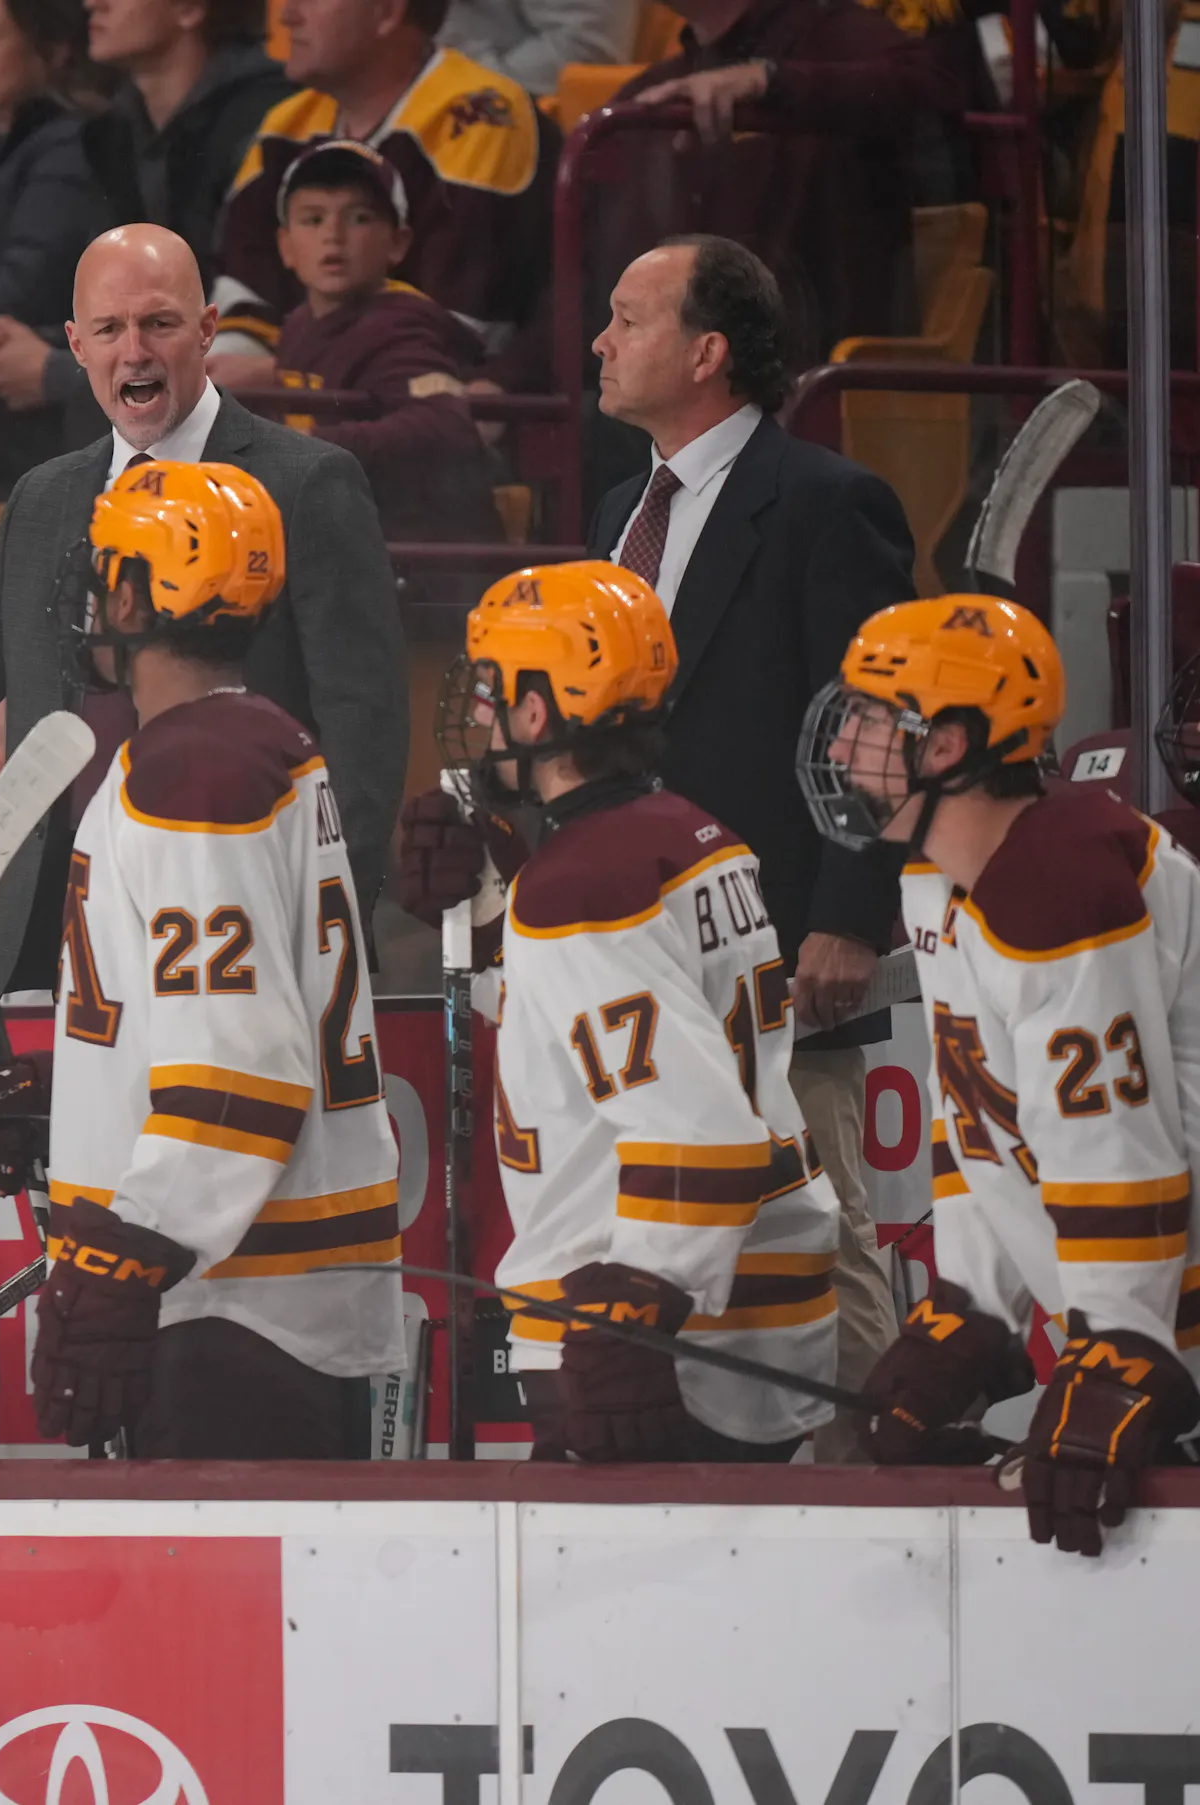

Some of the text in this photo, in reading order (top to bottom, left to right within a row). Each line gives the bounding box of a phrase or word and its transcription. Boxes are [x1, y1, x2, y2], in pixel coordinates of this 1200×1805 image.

[247, 551, 269, 573] 22
[1086, 754, 1111, 775] 14
[150, 904, 257, 996] 22
[569, 990, 659, 1104] 17
[1047, 1011, 1150, 1119] 23
[59, 1236, 167, 1288] CCM
